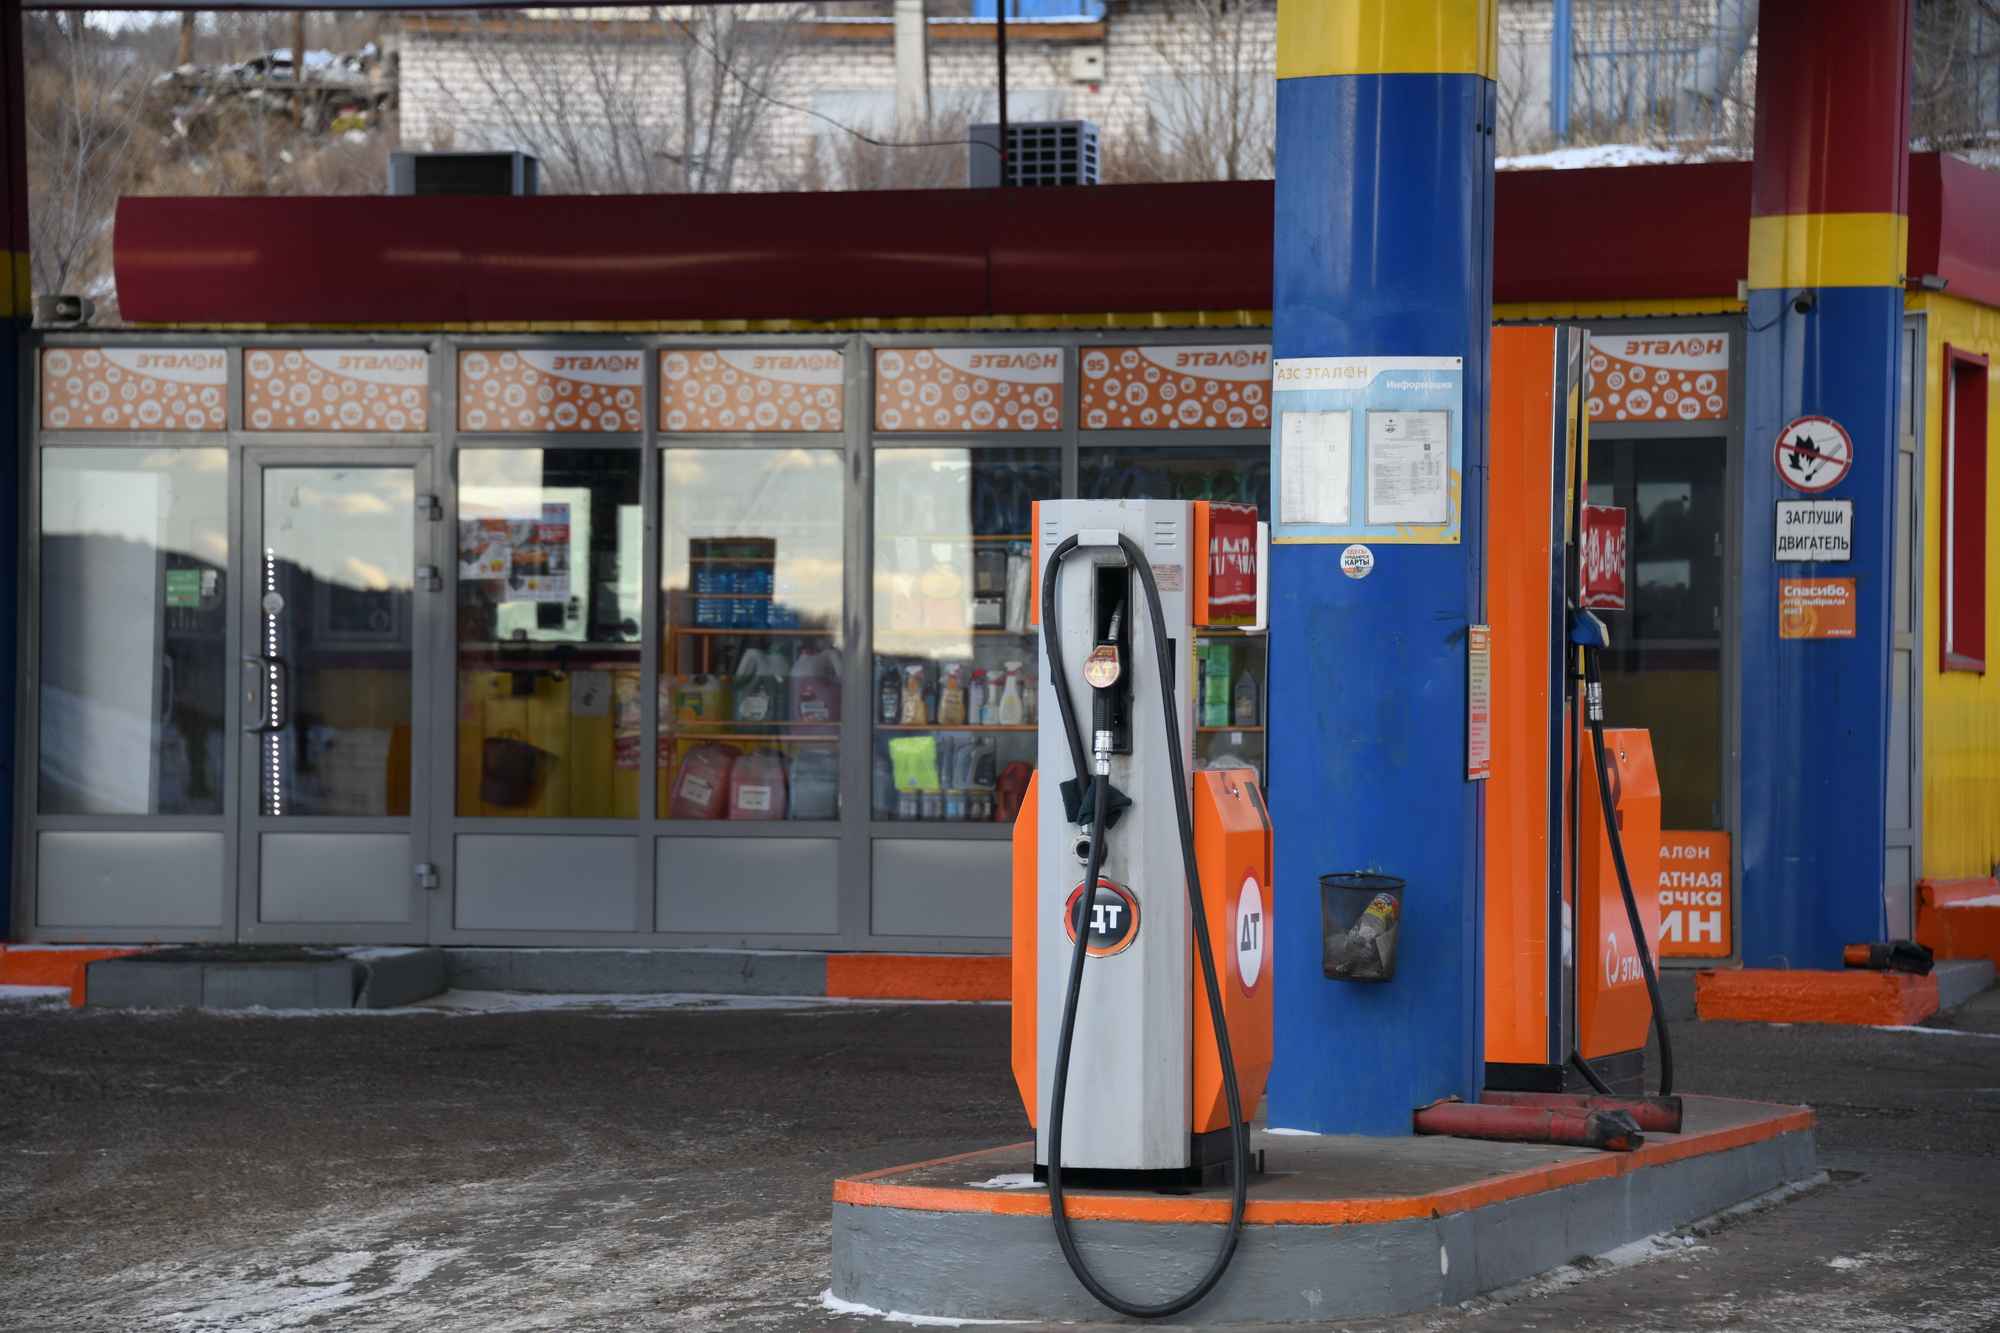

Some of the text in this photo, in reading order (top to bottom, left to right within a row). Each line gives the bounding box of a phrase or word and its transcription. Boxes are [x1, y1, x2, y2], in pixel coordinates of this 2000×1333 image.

[1785, 510, 1843, 525] ЗАГЛУШИ
[1778, 536, 1849, 552] ДВИГАТЕЛЬ
[1344, 559, 1370, 567] КАРТЫ
[1784, 585, 1849, 598] Спасибо,
[1659, 846, 1711, 859] АЛОН
[1659, 872, 1723, 887] АТНАЯ
[1659, 891, 1722, 906] ачка
[1089, 904, 1122, 934] ДТ
[1659, 910, 1722, 943] ИН
[1240, 912, 1260, 952] ДТ
